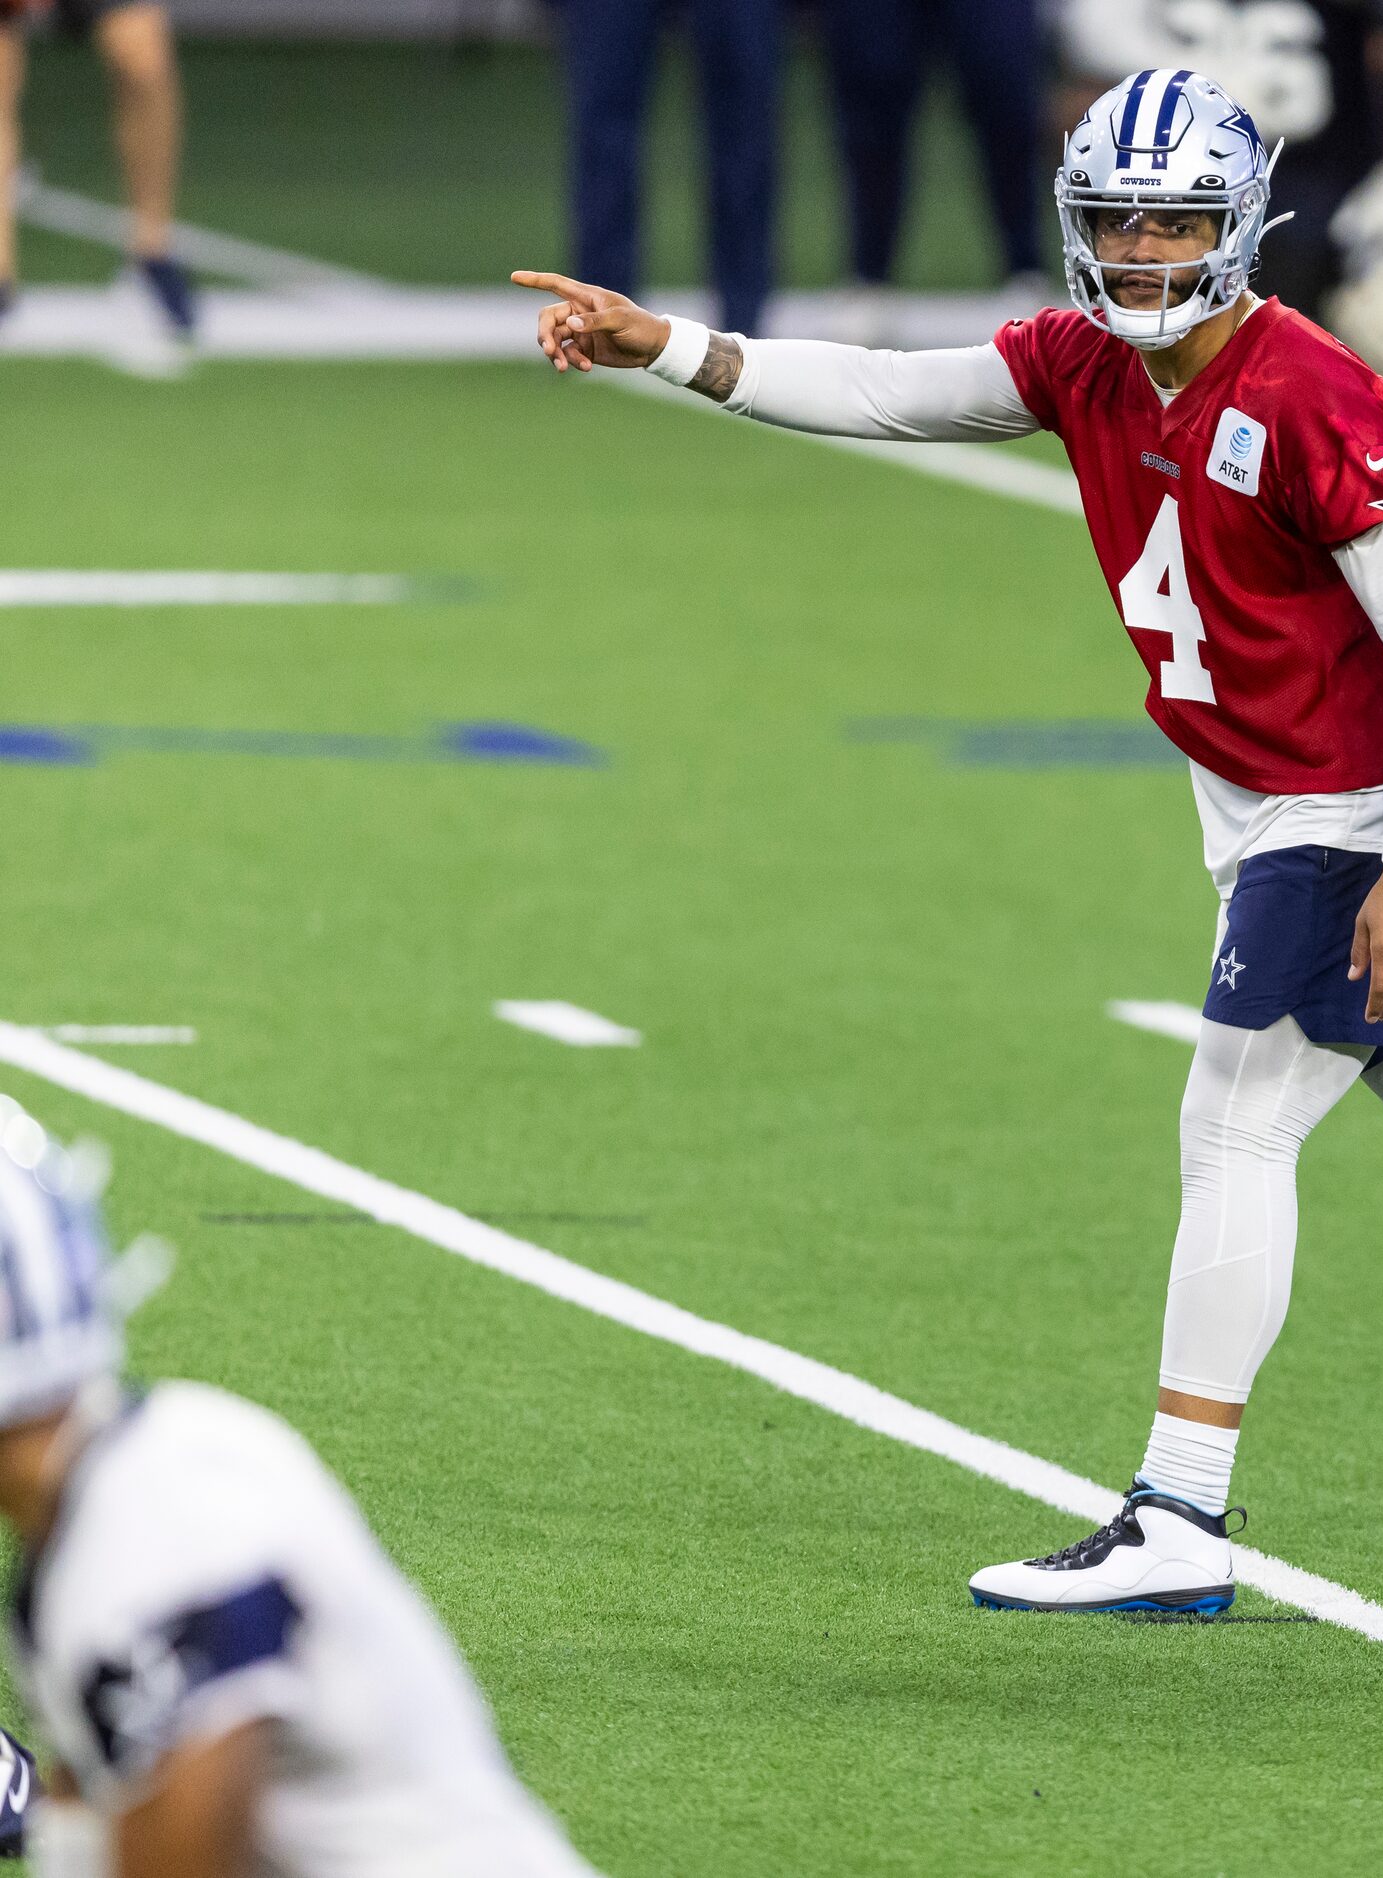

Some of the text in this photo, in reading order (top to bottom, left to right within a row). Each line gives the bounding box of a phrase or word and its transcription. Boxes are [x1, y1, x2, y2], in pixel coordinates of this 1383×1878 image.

[1120, 177, 1162, 186] COWBOYS
[1141, 451, 1180, 479] COWBOYS
[1219, 460, 1248, 483] AT&T
[1118, 493, 1217, 705] 4
